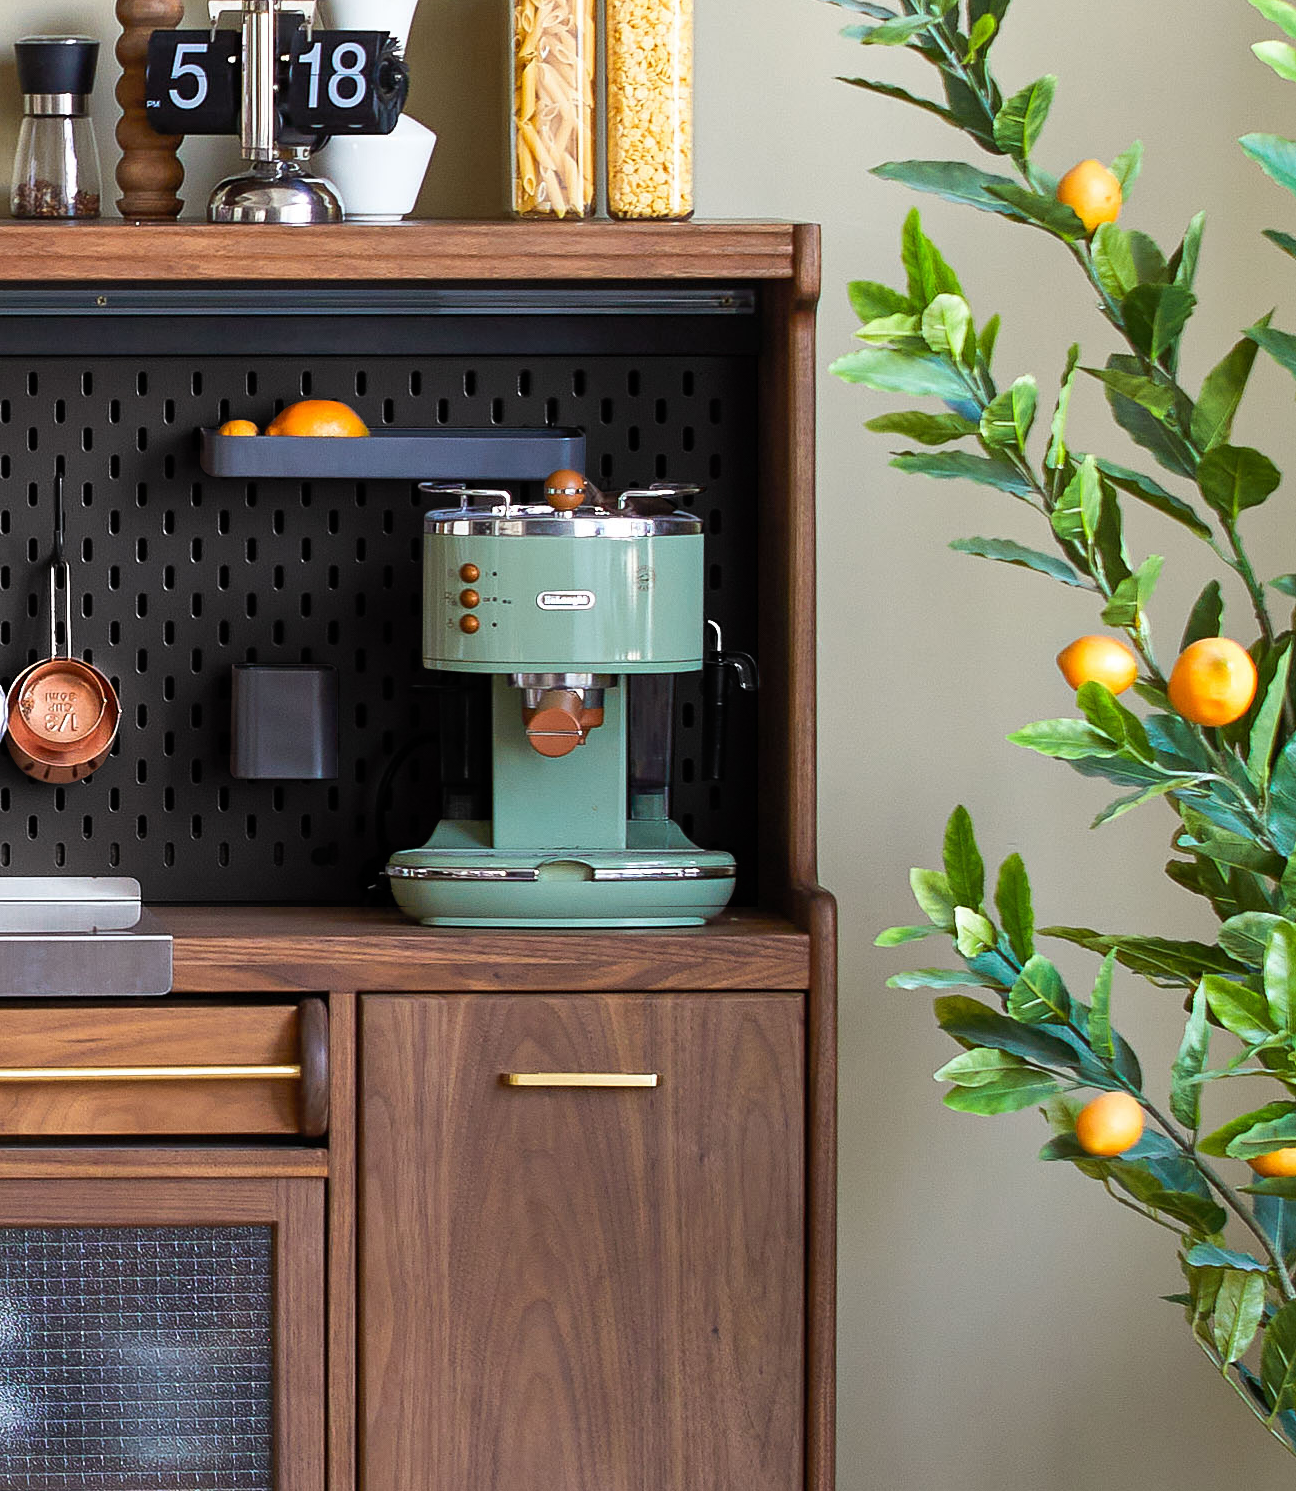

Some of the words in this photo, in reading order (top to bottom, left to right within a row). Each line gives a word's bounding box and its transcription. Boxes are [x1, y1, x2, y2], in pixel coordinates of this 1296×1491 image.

[168, 42, 208, 109] 5
[297, 41, 368, 109] 18
[48, 703, 74, 713] CUP
